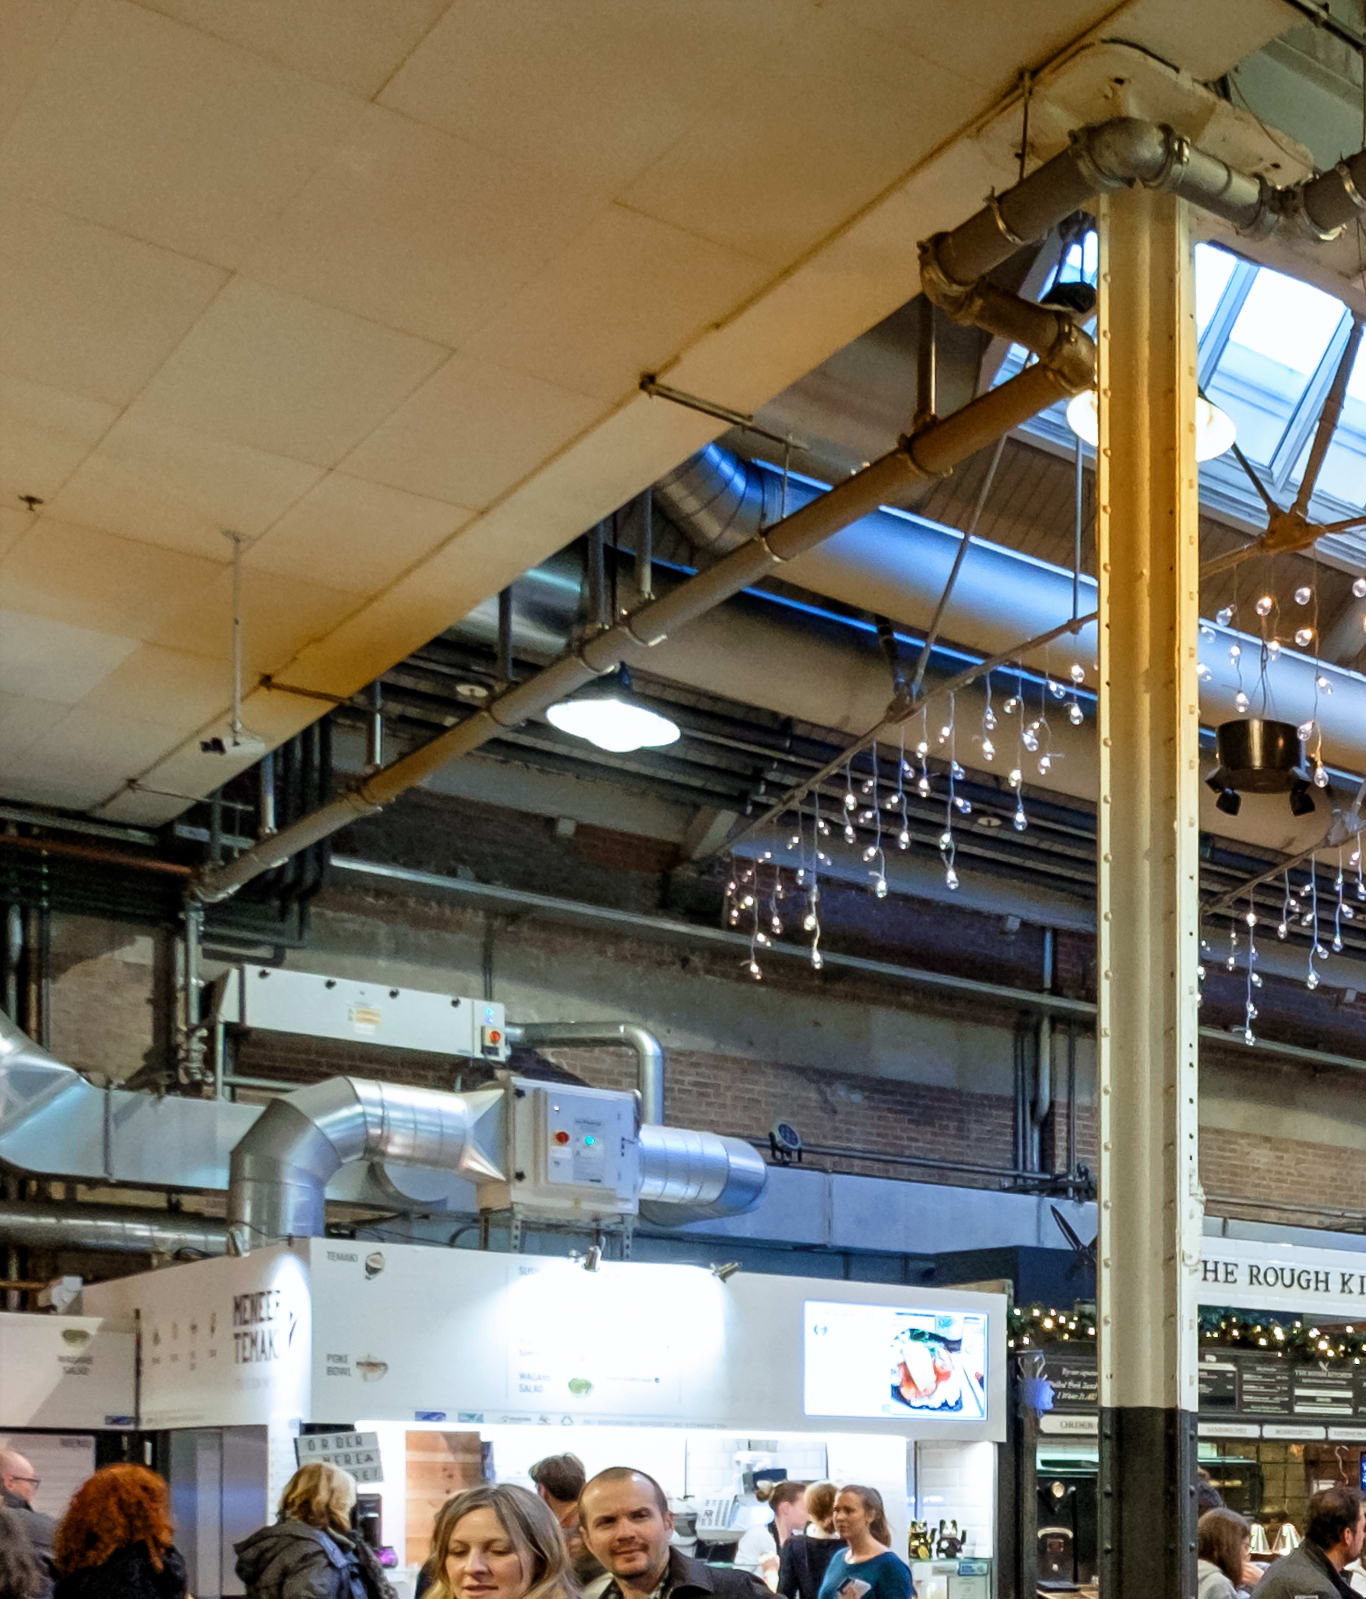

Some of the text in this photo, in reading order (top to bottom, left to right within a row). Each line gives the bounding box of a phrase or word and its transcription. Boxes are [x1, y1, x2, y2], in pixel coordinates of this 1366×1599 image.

[1201, 1260, 1238, 1284] HE
[1248, 1264, 1331, 1293] ROUGH
[234, 1329, 279, 1364] TEMAK
